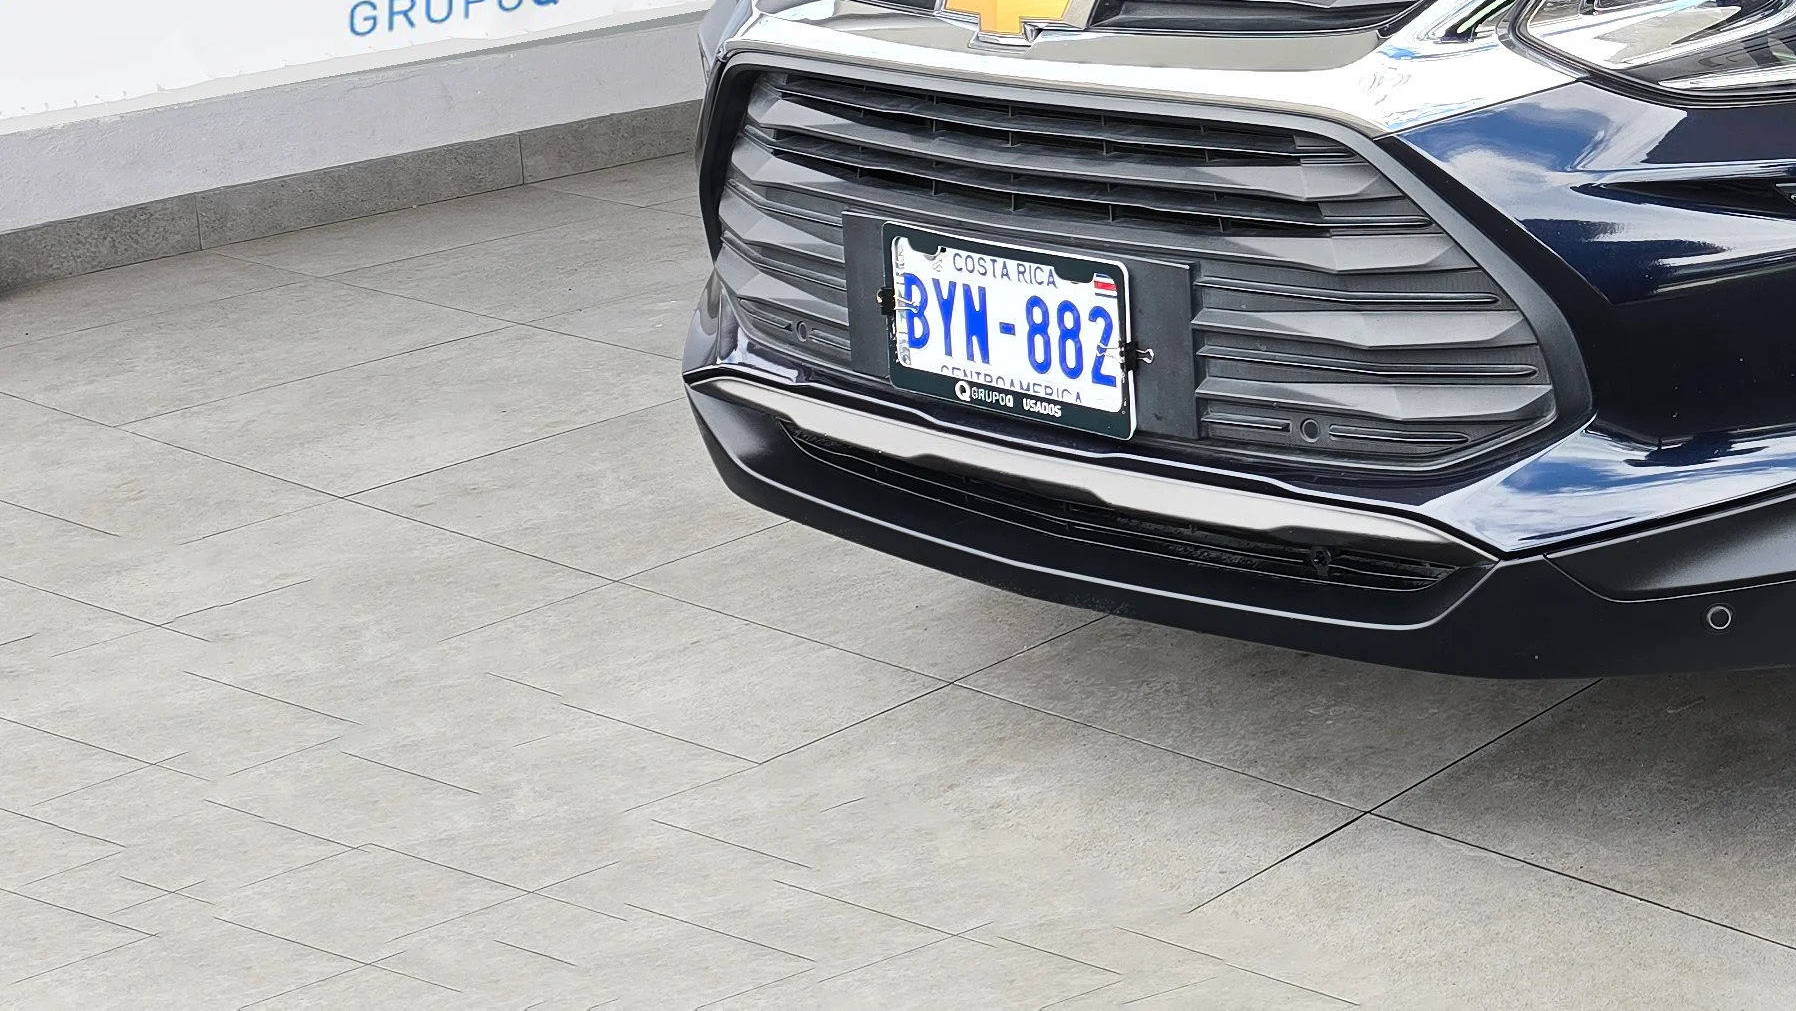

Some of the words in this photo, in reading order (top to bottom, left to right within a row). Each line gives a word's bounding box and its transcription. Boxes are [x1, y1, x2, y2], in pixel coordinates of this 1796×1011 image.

[952, 252, 1011, 281] COSTA
[1016, 262, 1059, 288] RICA
[904, 272, 1117, 387] BYN-882
[1022, 397, 1063, 417] USADOS
